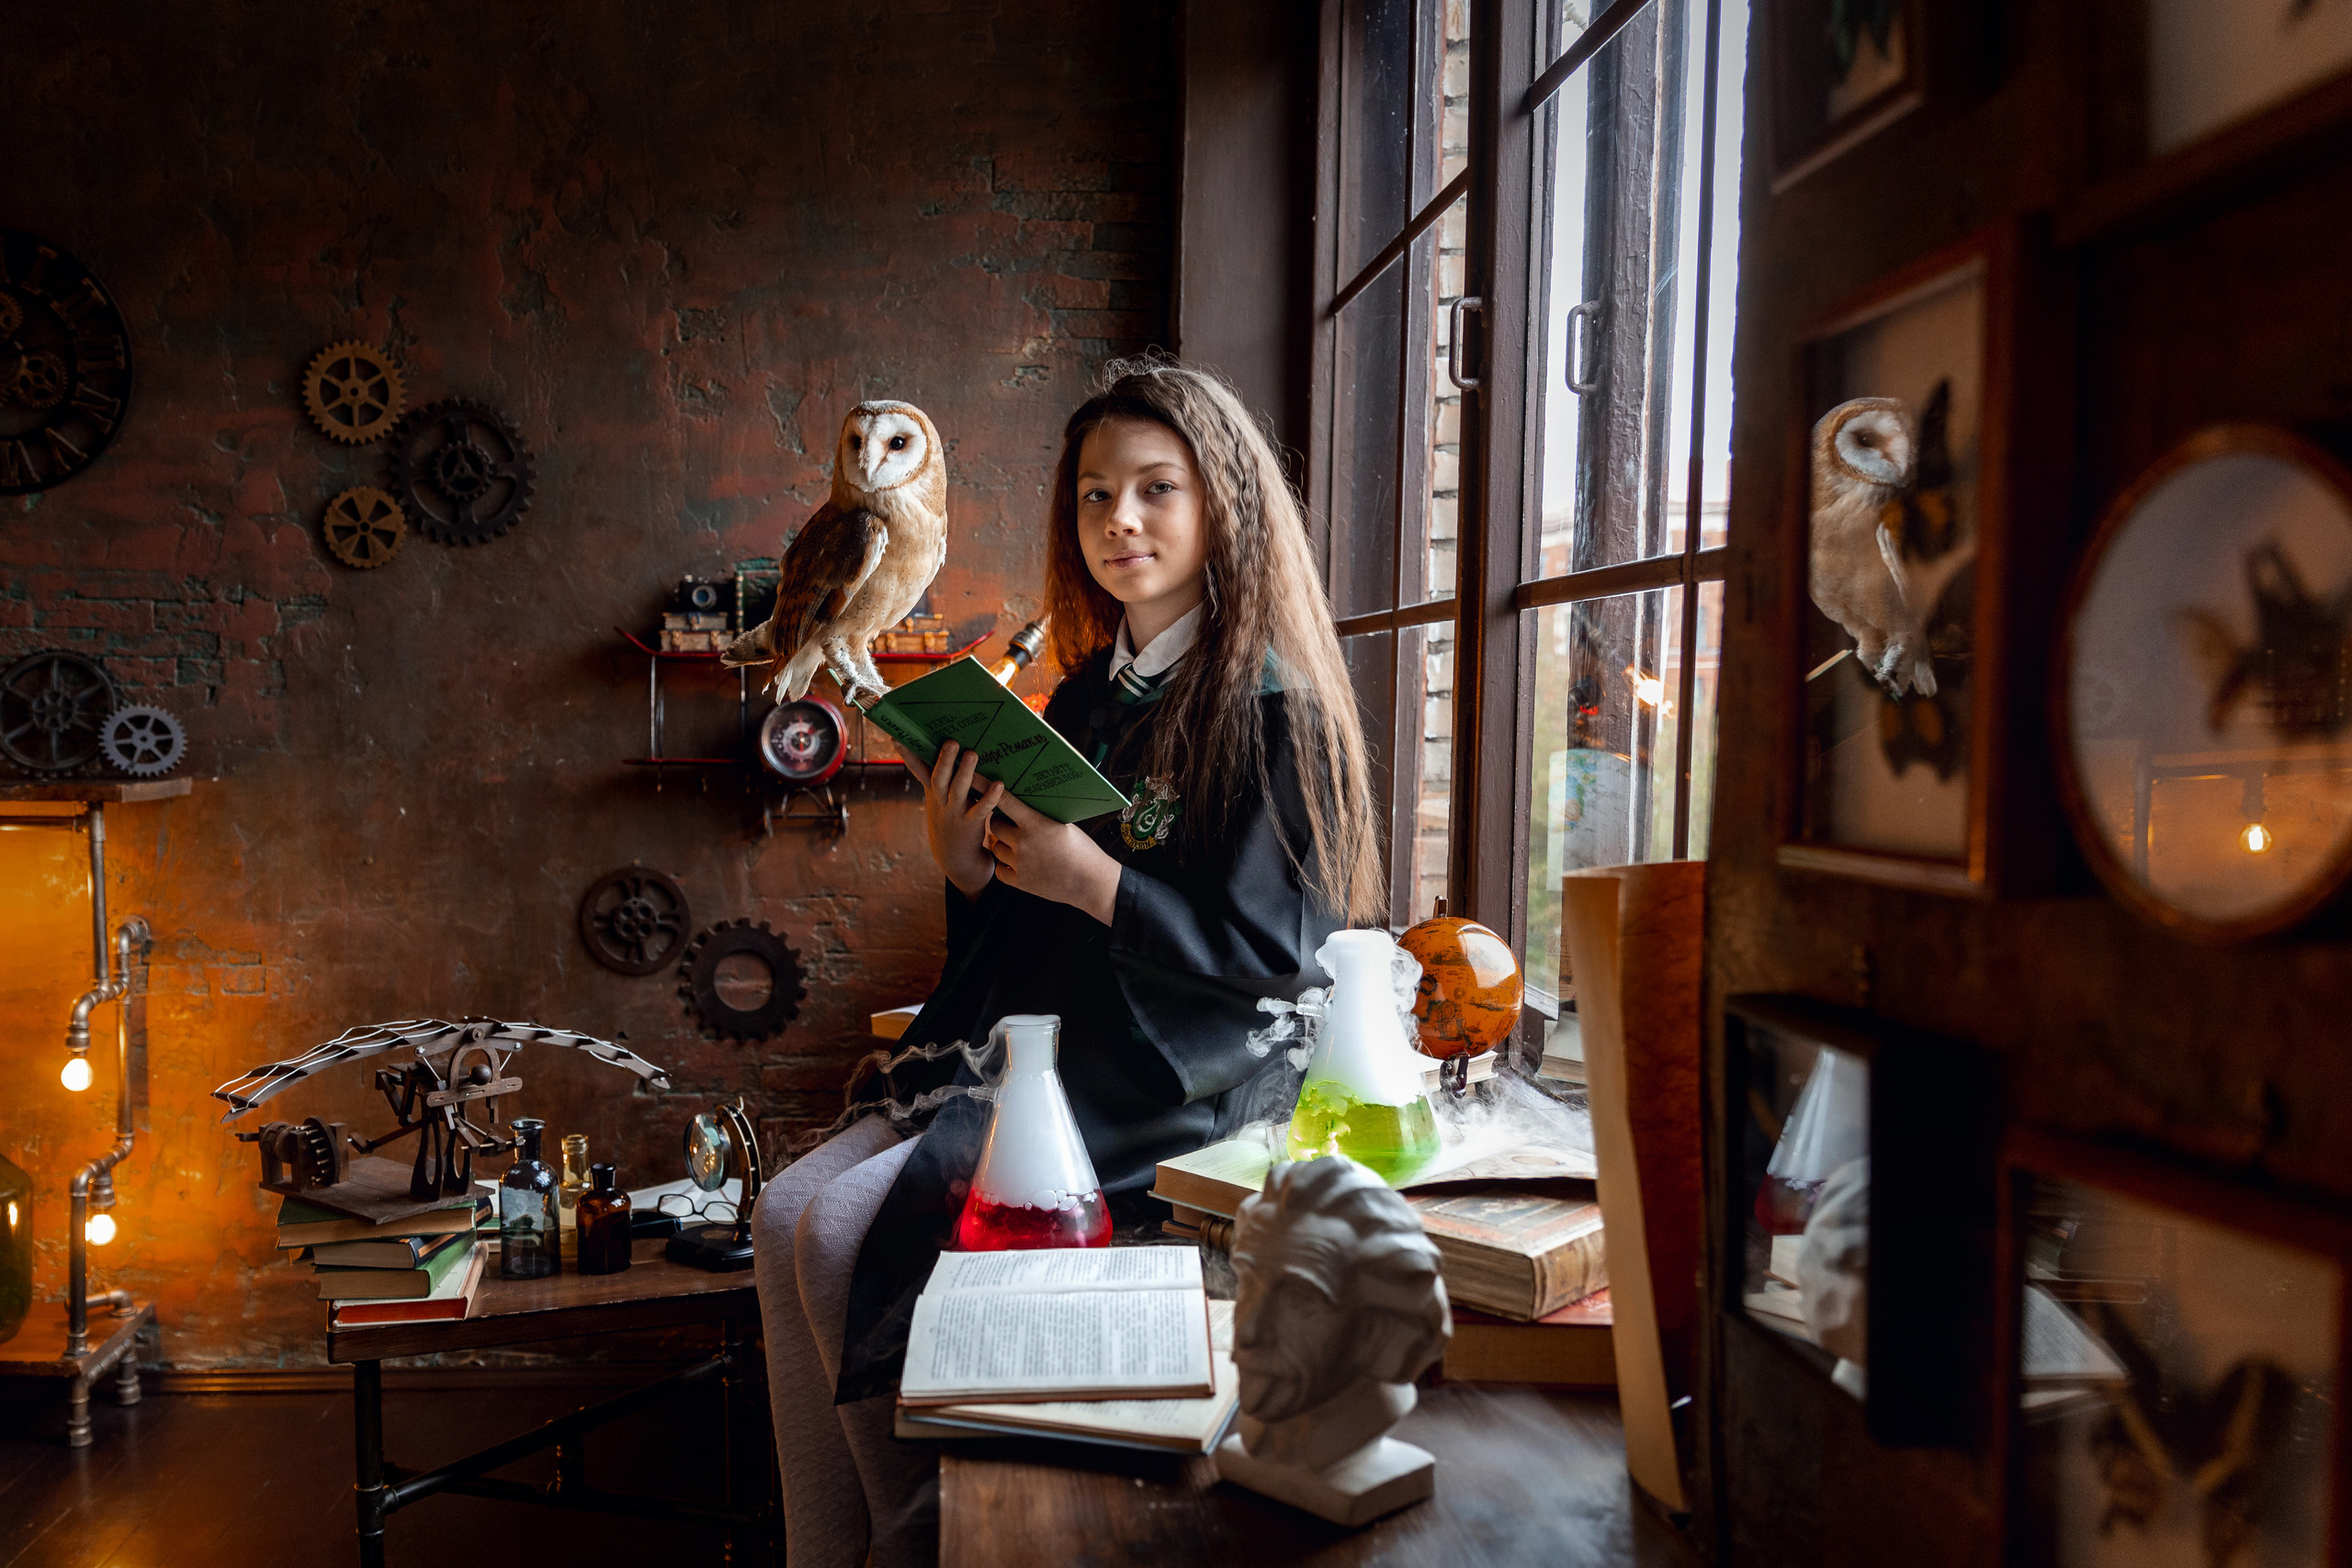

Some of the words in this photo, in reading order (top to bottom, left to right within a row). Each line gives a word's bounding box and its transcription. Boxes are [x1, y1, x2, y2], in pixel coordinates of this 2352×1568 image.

[925, 714, 957, 730] УЛИЦА
[956, 712, 988, 728] СОЛНЦ
[978, 750, 1003, 766] ндре
[998, 734, 1047, 756] Ремакль
[1033, 762, 1075, 781] ЛЕТАЙТЕ
